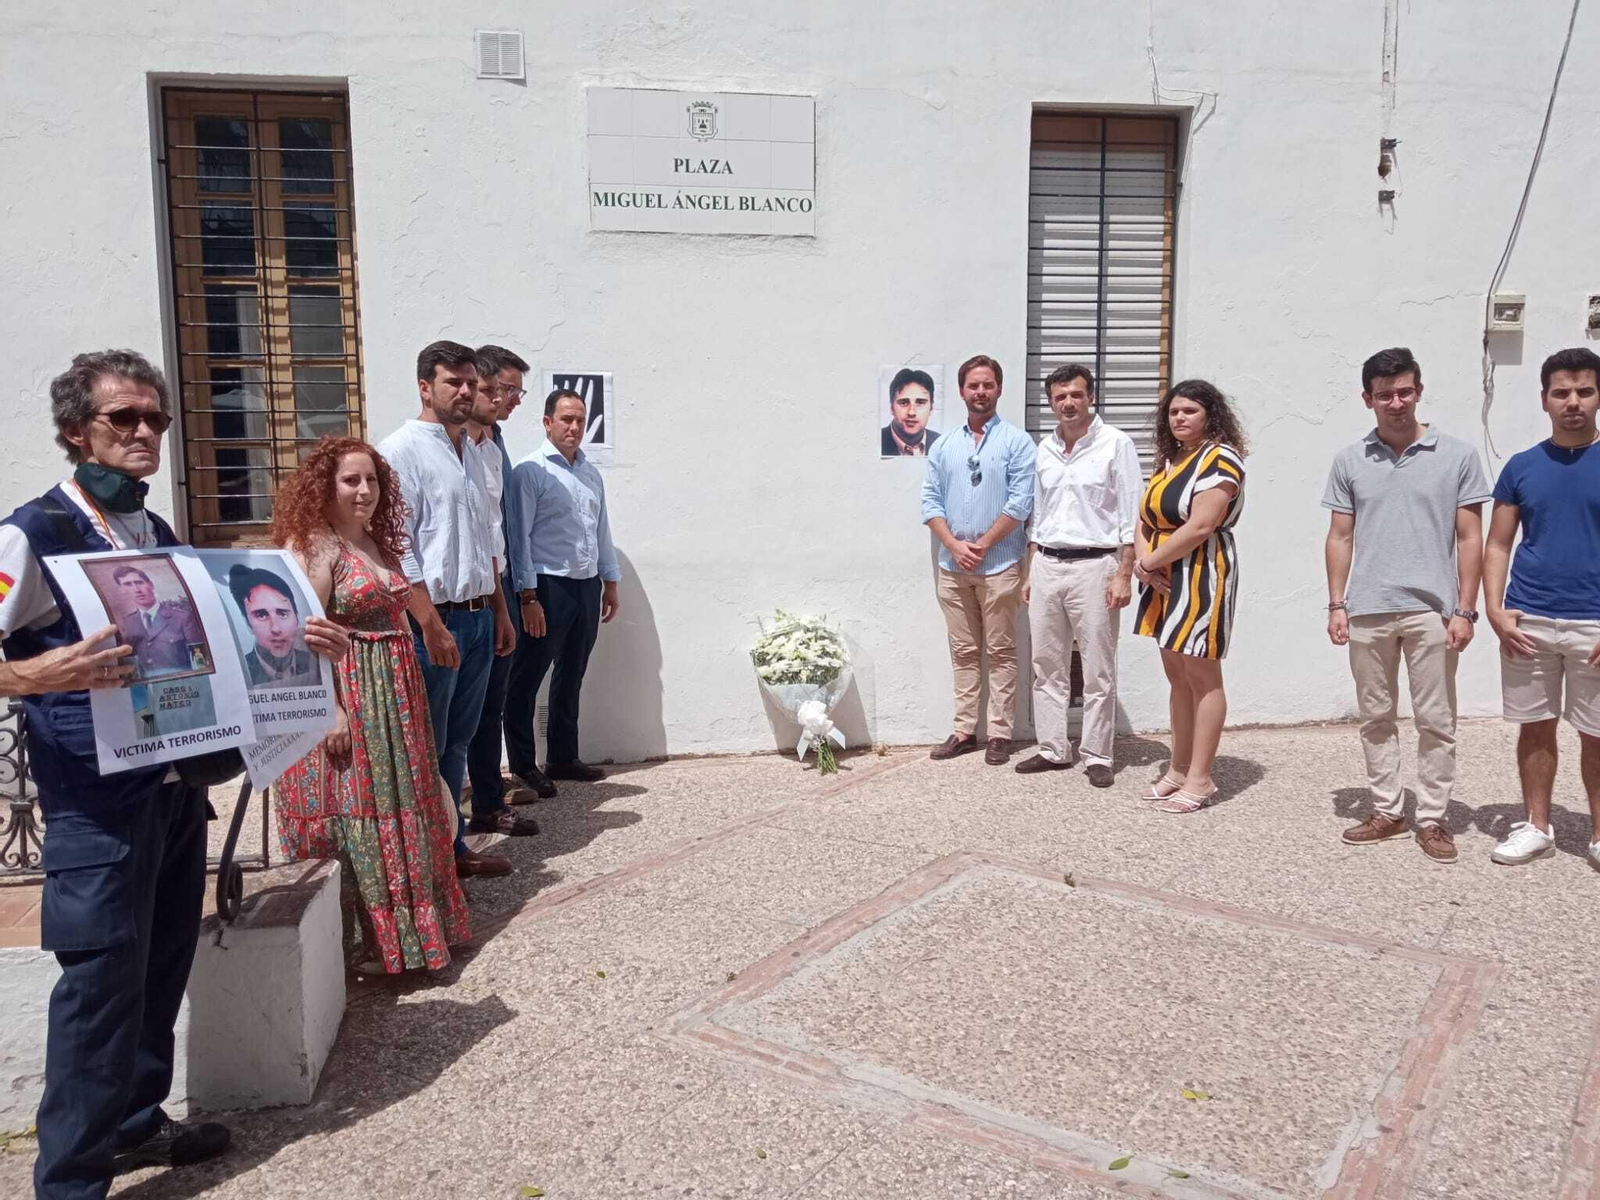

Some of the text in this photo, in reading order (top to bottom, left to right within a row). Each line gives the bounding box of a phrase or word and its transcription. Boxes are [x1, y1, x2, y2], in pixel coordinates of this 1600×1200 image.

[673, 158, 733, 175] PLAZA
[593, 190, 813, 214] MIGUEL ÁNGEL BLANCO
[248, 689, 327, 704] GUEL ANGEL BLANCO
[252, 708, 327, 724] TIMA TERRORISMO
[113, 725, 242, 759] VICTIMA TERRORISMO
[252, 763, 261, 773] Y
